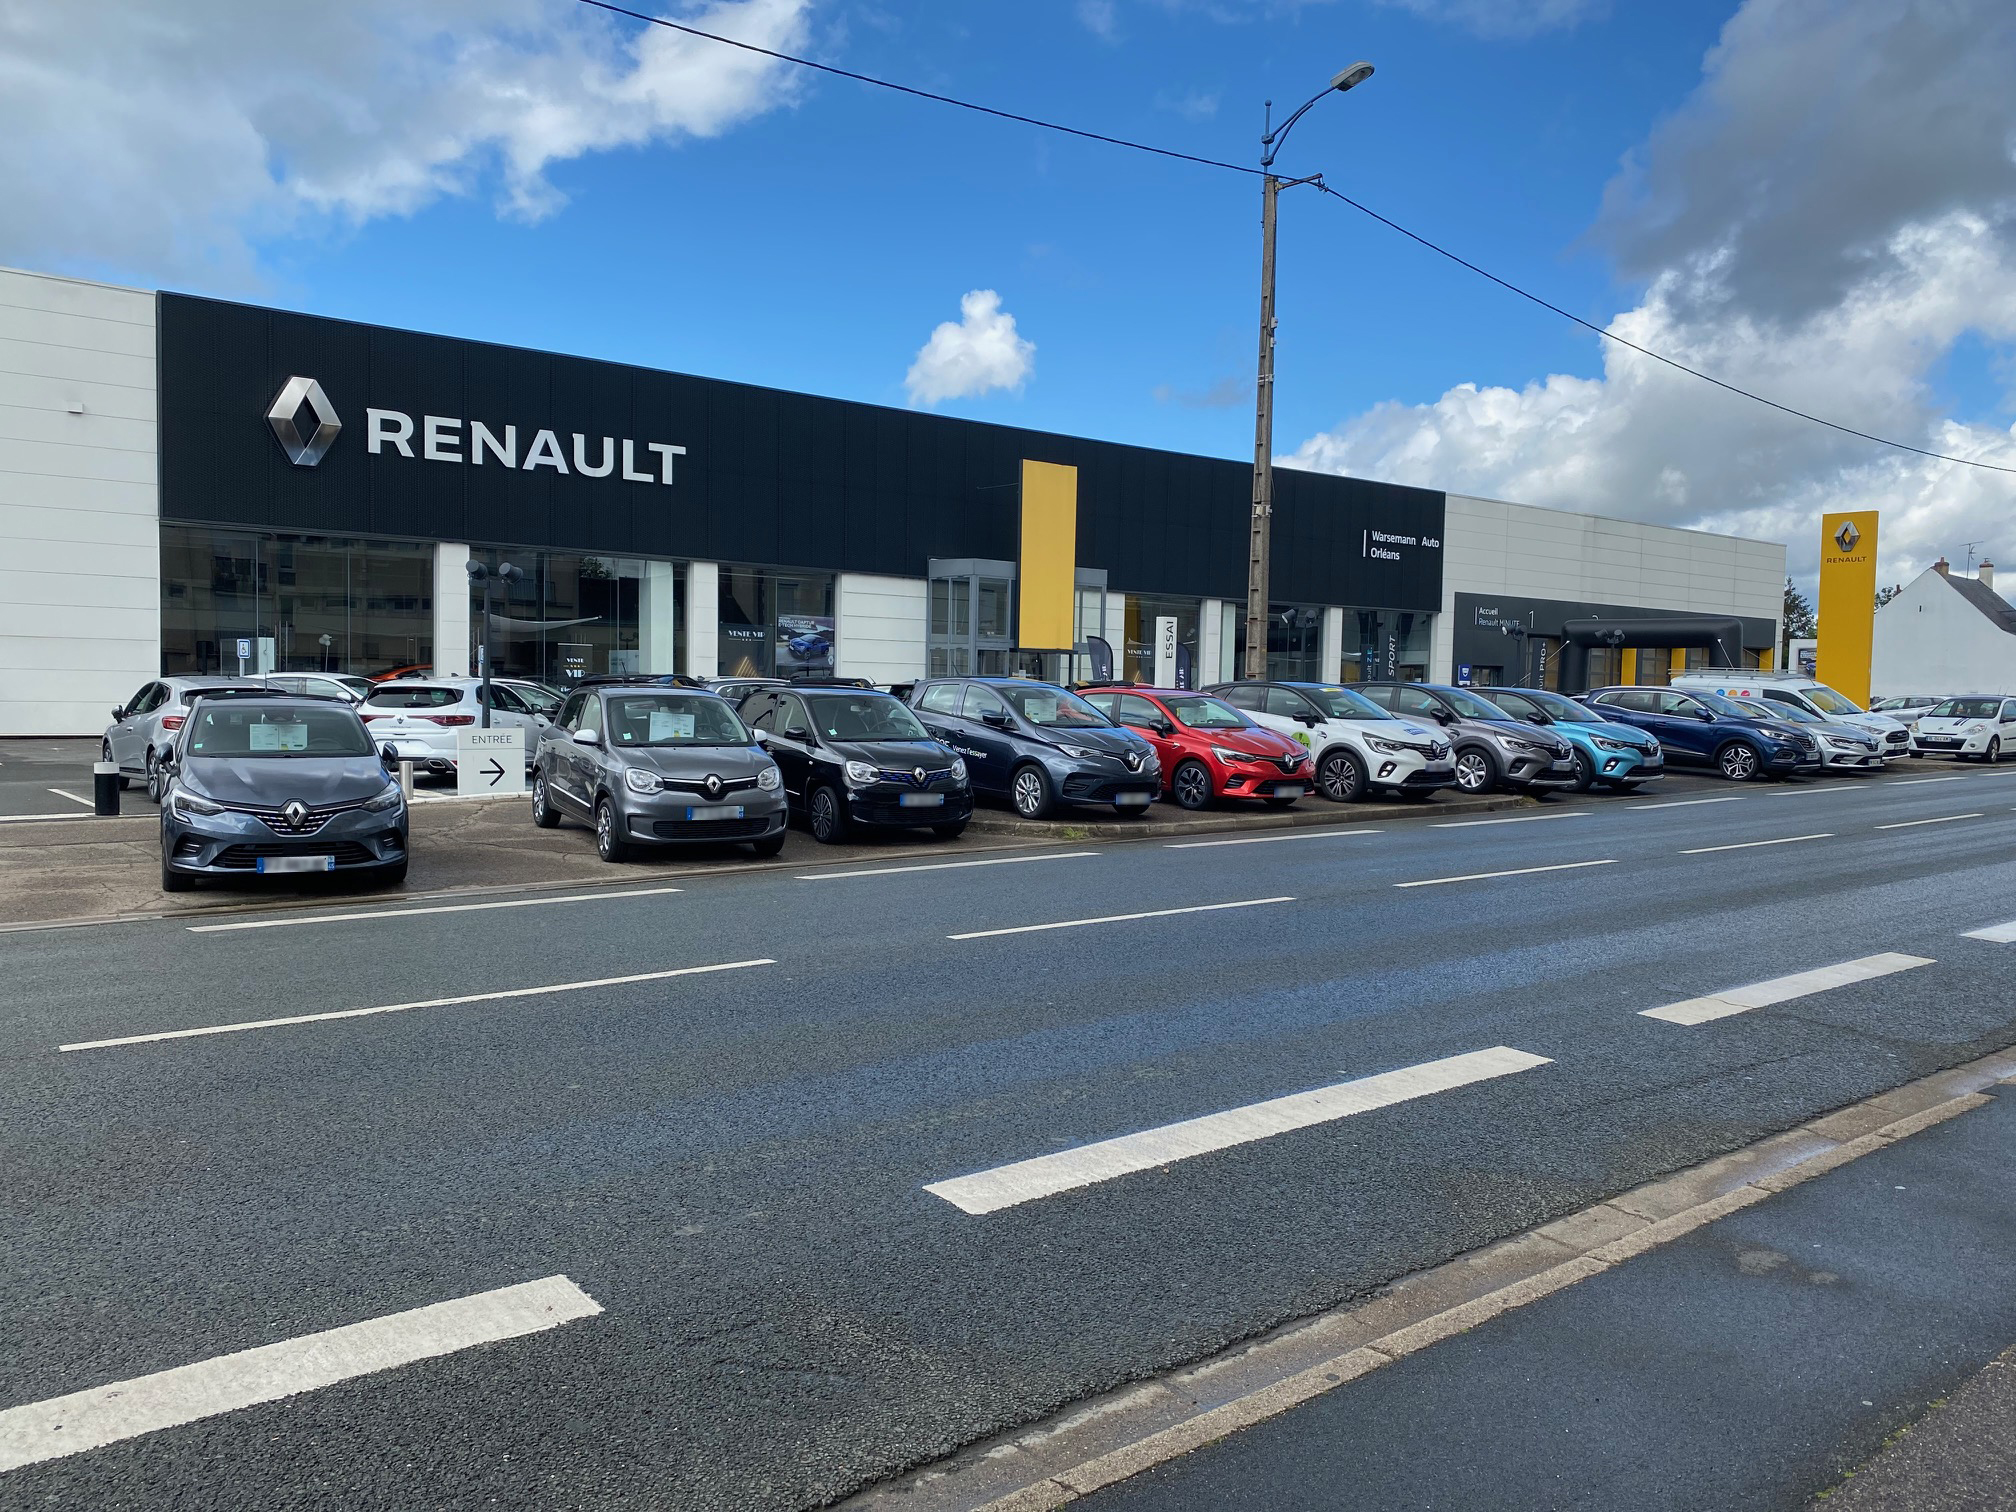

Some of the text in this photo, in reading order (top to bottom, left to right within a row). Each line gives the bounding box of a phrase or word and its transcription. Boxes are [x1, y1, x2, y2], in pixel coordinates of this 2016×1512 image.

[366, 407, 687, 485] RENAULT
[1371, 530, 1440, 548] Warsemann Auto
[1370, 547, 1400, 560] Orléans
[1826, 556, 1867, 564] RENAULT
[1479, 606, 1498, 616] Accueil
[1478, 617, 1498, 627] Renault
[1529, 610, 1534, 629] 1
[728, 630, 752, 638] VENTE
[1165, 621, 1174, 659] ESSAI
[1388, 634, 1396, 677] SPORT
[565, 669, 586, 678] VIP
[472, 733, 512, 744] ENTRÉE
[952, 744, 967, 754] Venez
[967, 747, 988, 759] l'essayer
